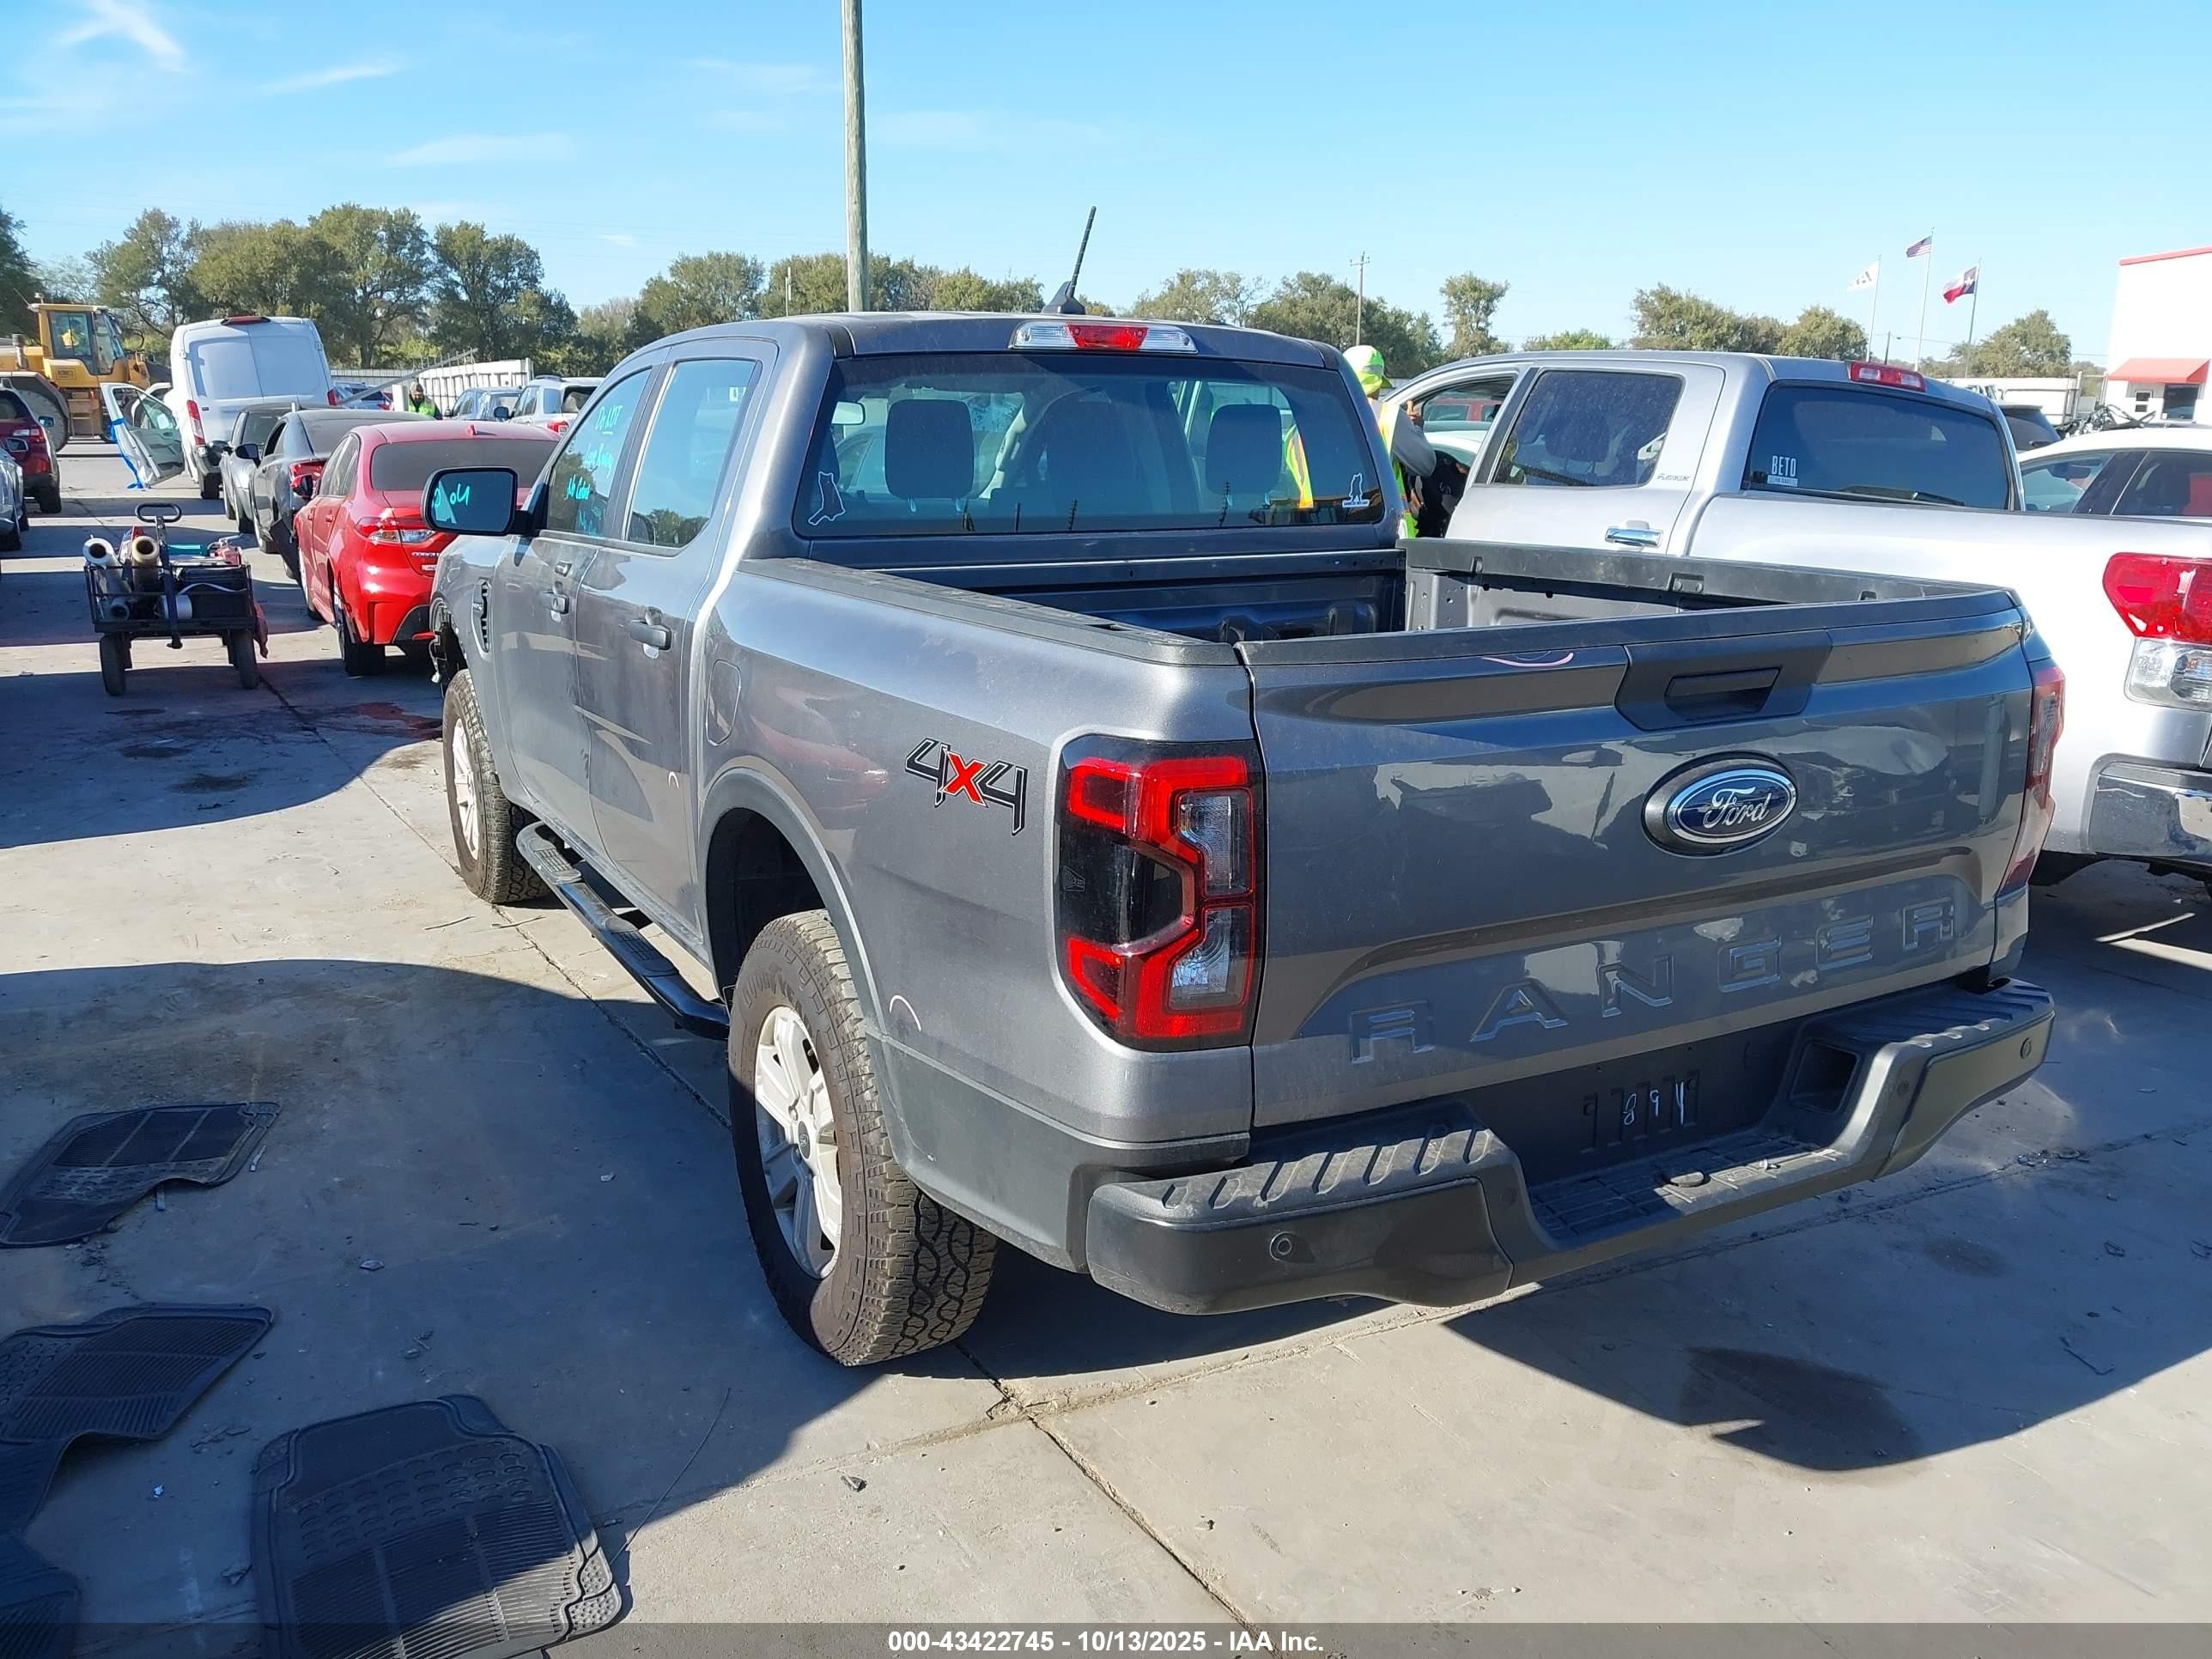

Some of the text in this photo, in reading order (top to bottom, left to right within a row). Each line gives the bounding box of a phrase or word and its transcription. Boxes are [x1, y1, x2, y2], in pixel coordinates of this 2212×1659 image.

[1771, 455, 1796, 477] BETO
[1703, 786, 1772, 829] Ford
[1349, 896, 1955, 1065] RANGER
